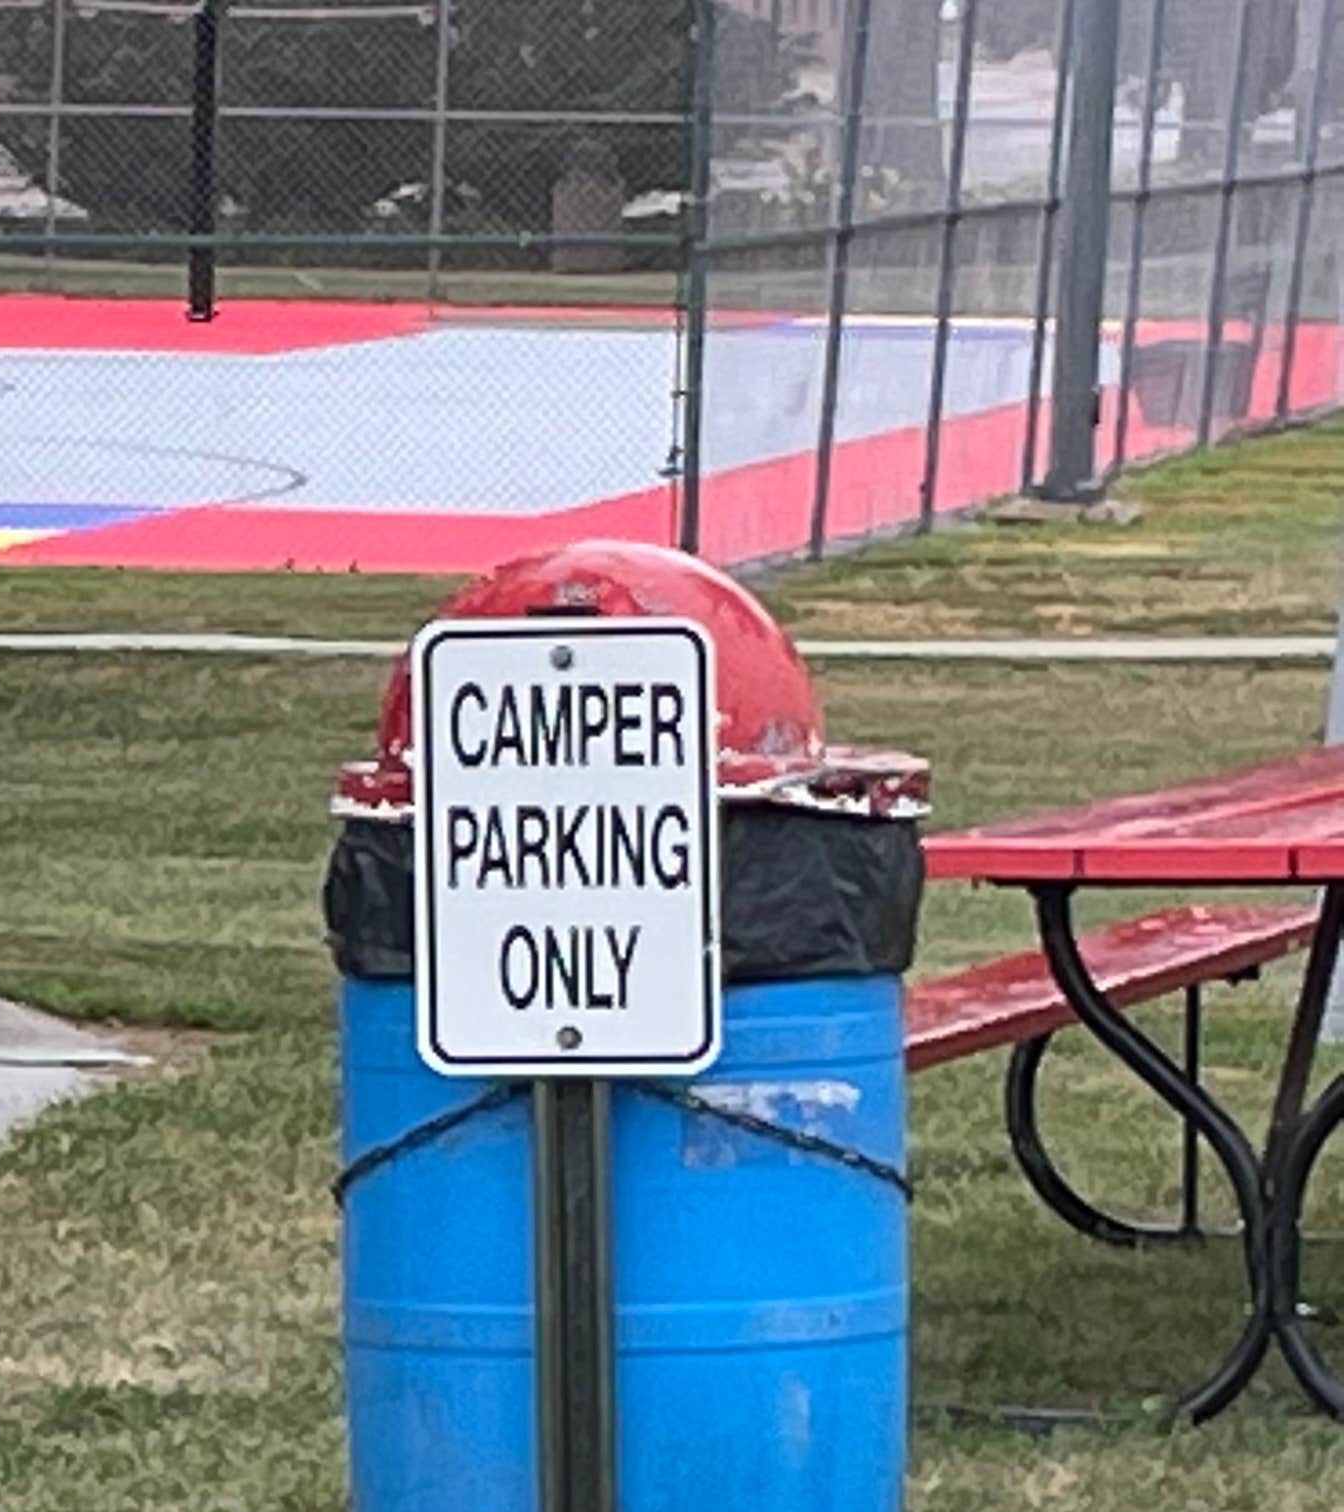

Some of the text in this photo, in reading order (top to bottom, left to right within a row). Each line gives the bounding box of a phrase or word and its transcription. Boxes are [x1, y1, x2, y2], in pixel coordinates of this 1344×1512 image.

[450, 682, 685, 767] CAMPER
[447, 805, 690, 890] PARKING
[499, 925, 640, 1010] ONLY
